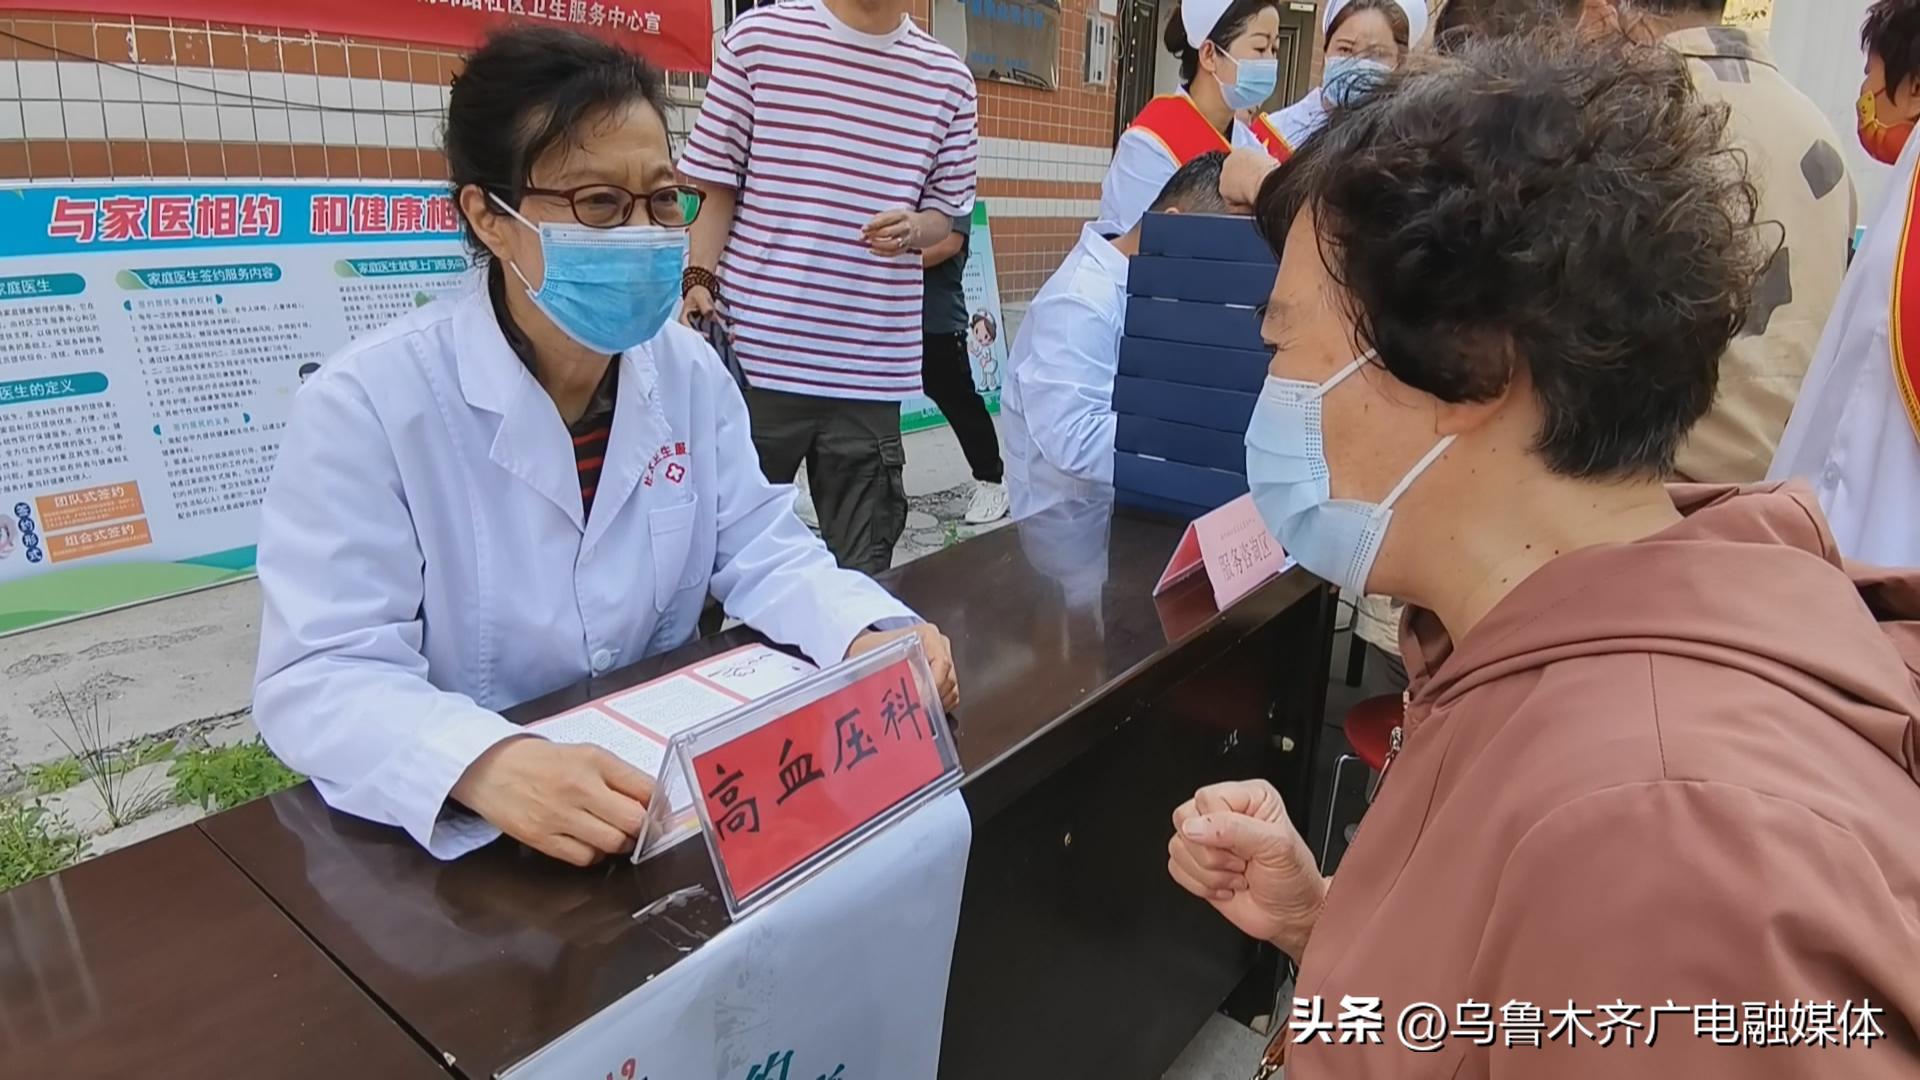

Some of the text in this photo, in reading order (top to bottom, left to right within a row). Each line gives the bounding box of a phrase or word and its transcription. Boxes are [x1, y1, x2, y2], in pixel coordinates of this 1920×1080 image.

[48, 195, 459, 243] 与家医相约 和健康相
[147, 267, 275, 293] 家庭医生签约服务内容
[0, 379, 76, 400] 医生的定义
[54, 485, 125, 508] 团队式签约
[15, 502, 42, 562] 签约形式
[64, 524, 135, 547] 组合式签约
[708, 677, 922, 841] 高血压科
